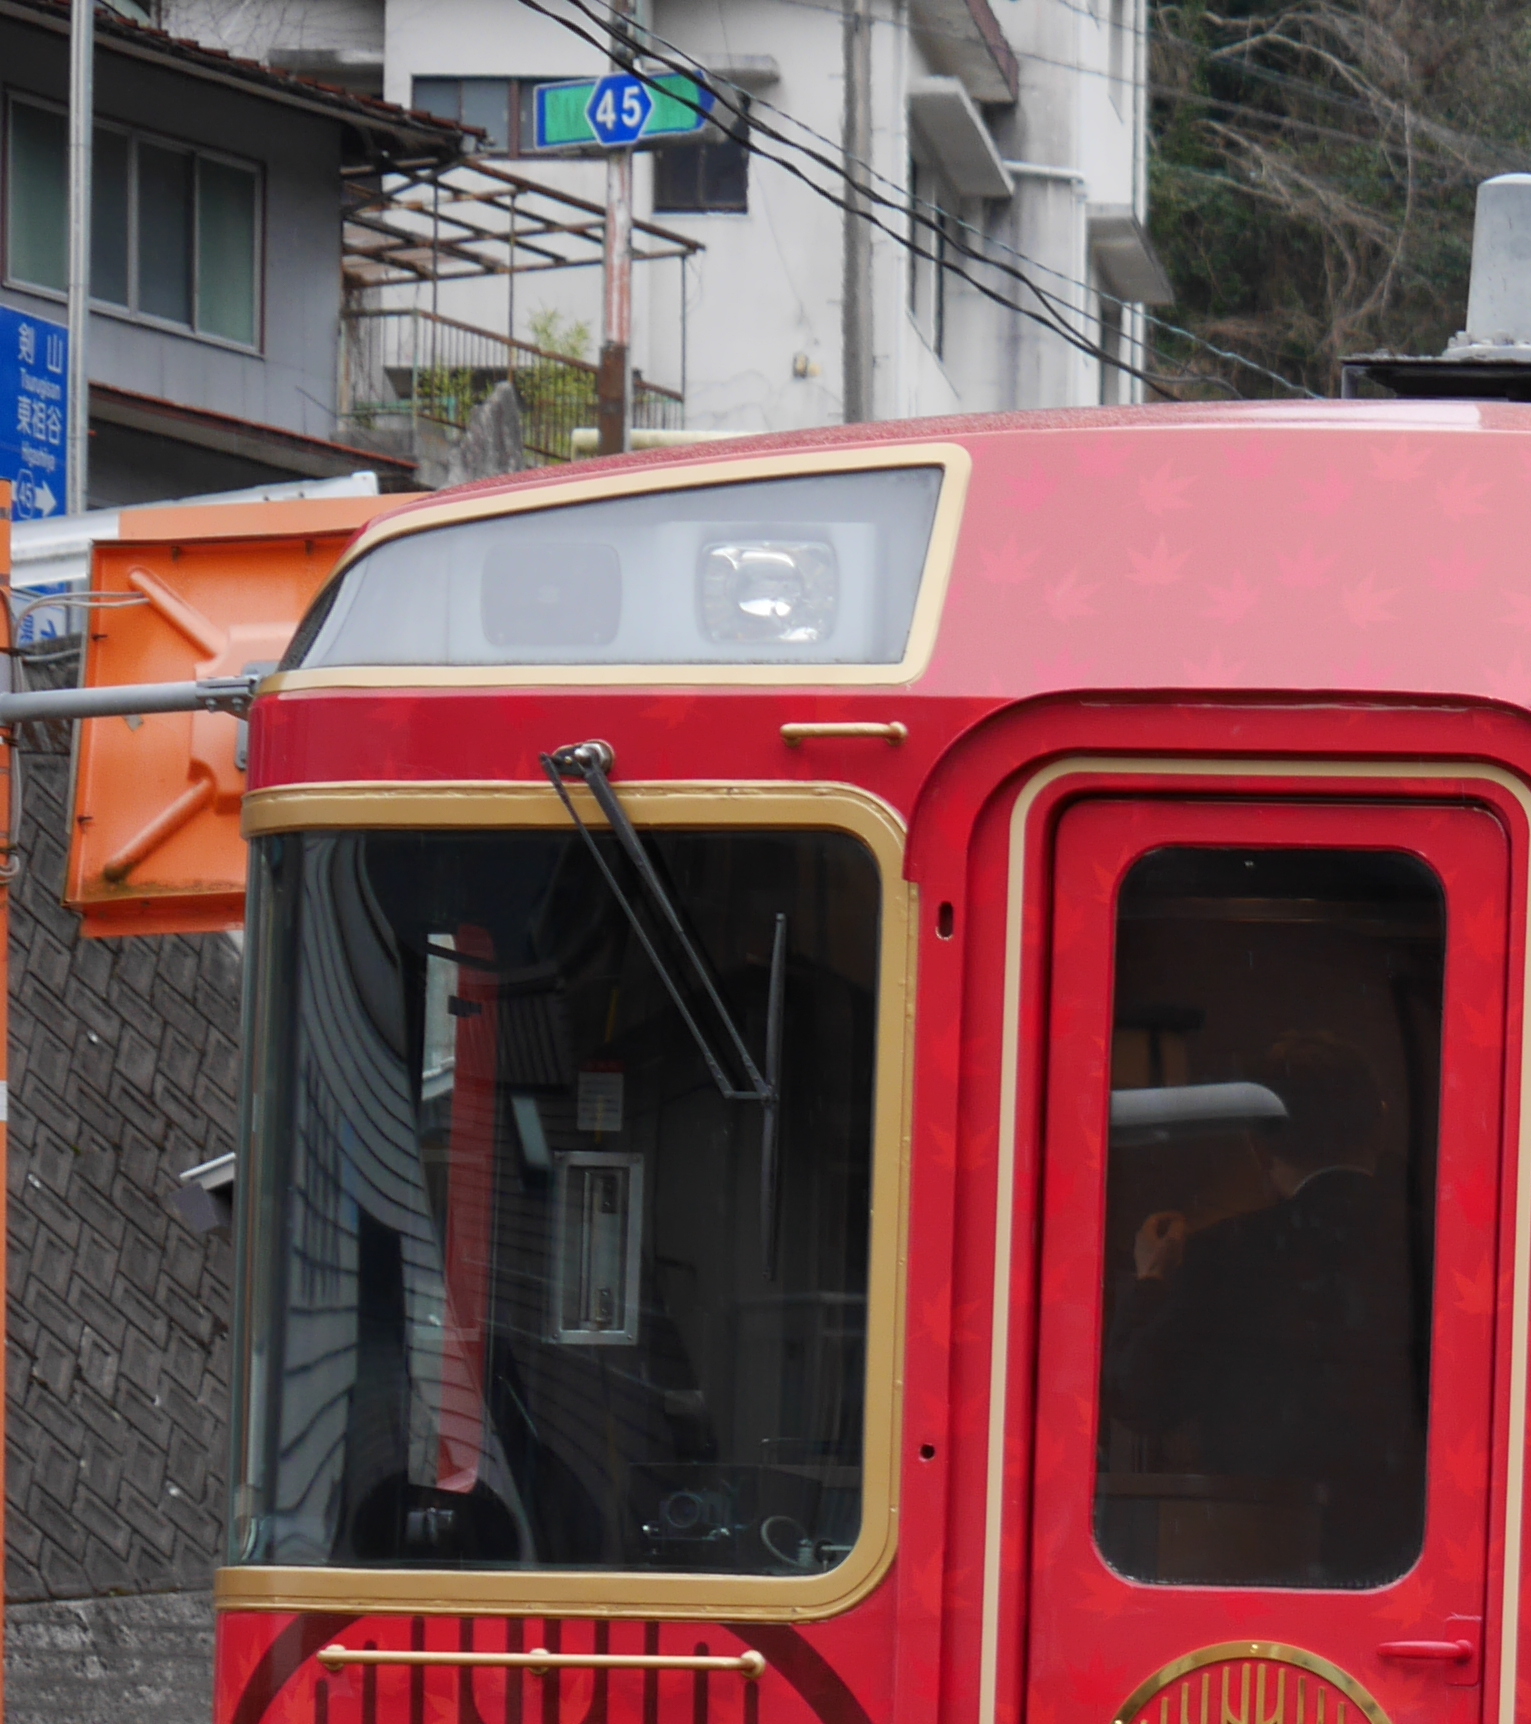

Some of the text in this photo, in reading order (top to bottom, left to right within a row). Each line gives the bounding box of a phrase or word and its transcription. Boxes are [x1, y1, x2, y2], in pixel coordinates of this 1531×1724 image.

[596, 86, 642, 130] 45
[17, 395, 62, 445] 東祖谷
